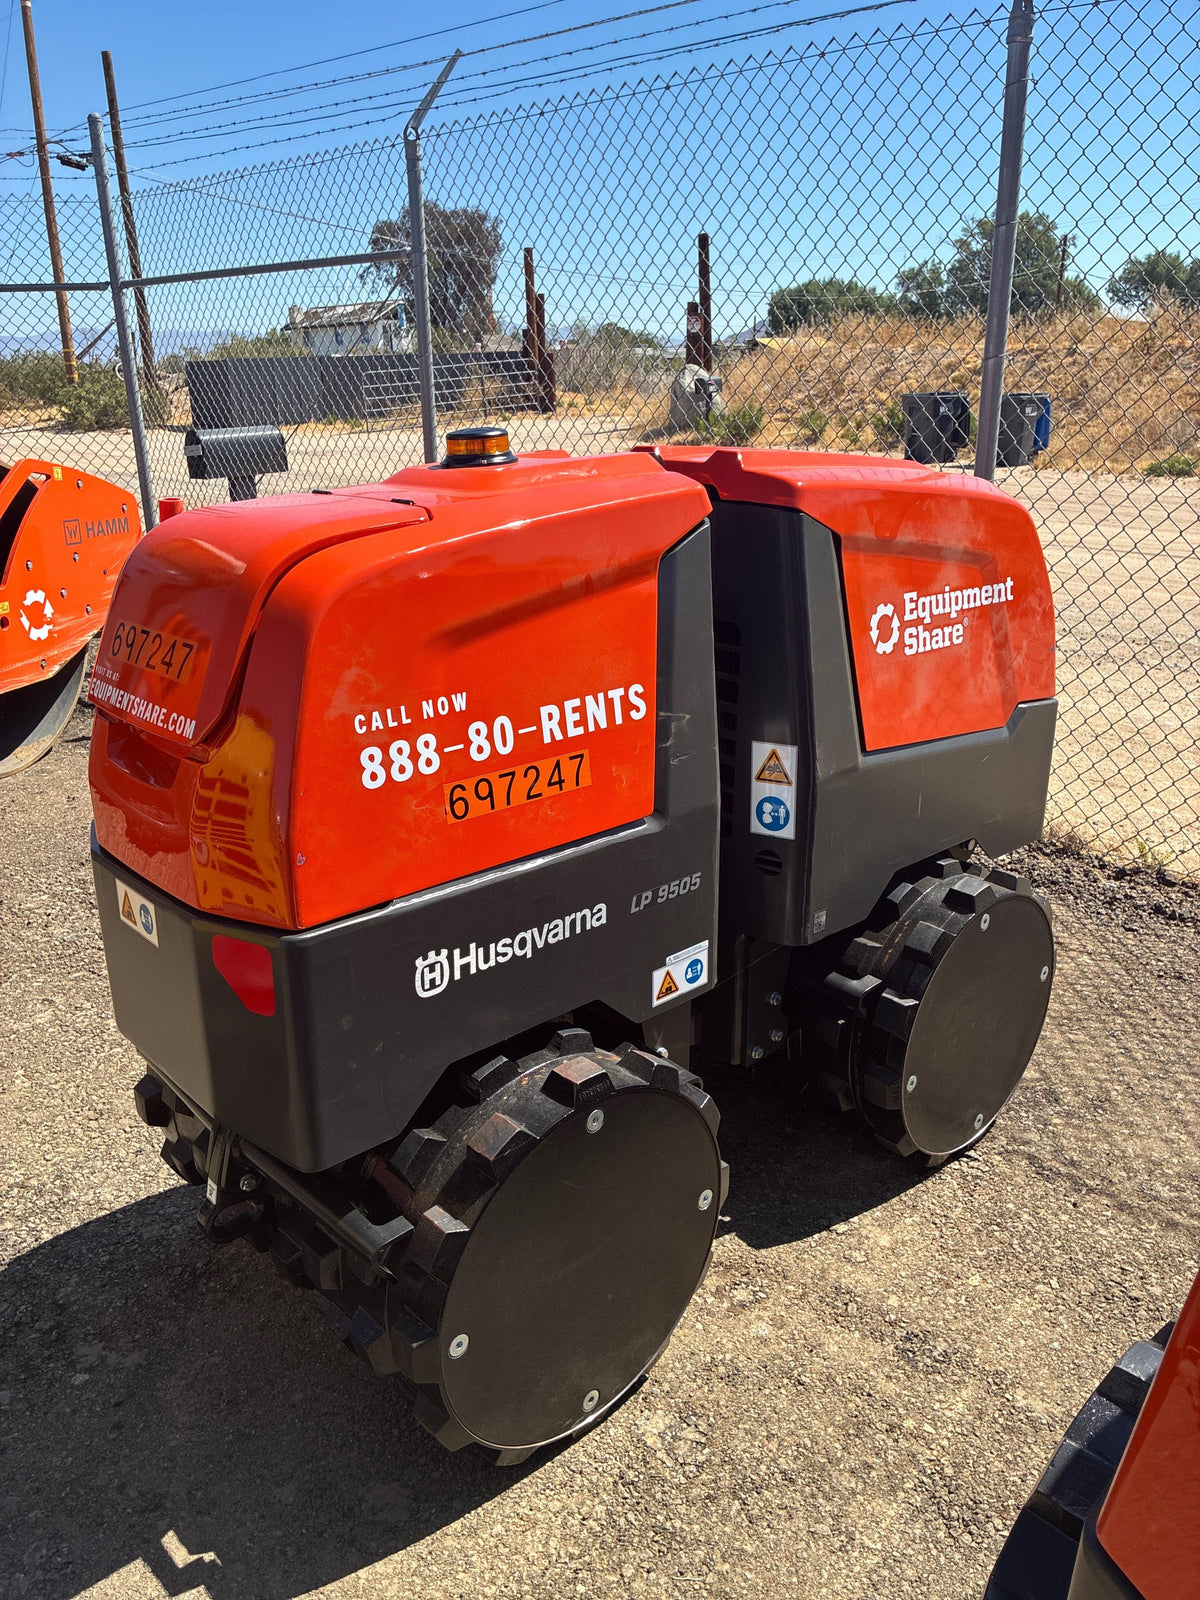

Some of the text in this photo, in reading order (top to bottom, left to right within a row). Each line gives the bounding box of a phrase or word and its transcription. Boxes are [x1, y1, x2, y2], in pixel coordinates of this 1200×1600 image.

[85, 517, 129, 538] HAMM
[903, 576, 1014, 624] Equipment
[111, 622, 194, 680] 697247
[89, 677, 196, 739] EQUIPMENTSHARE.COM
[354, 691, 467, 734] CALL NOW
[448, 753, 586, 820] 697247
[630, 871, 702, 914] LP 9505
[453, 902, 608, 981] Husqvarna
